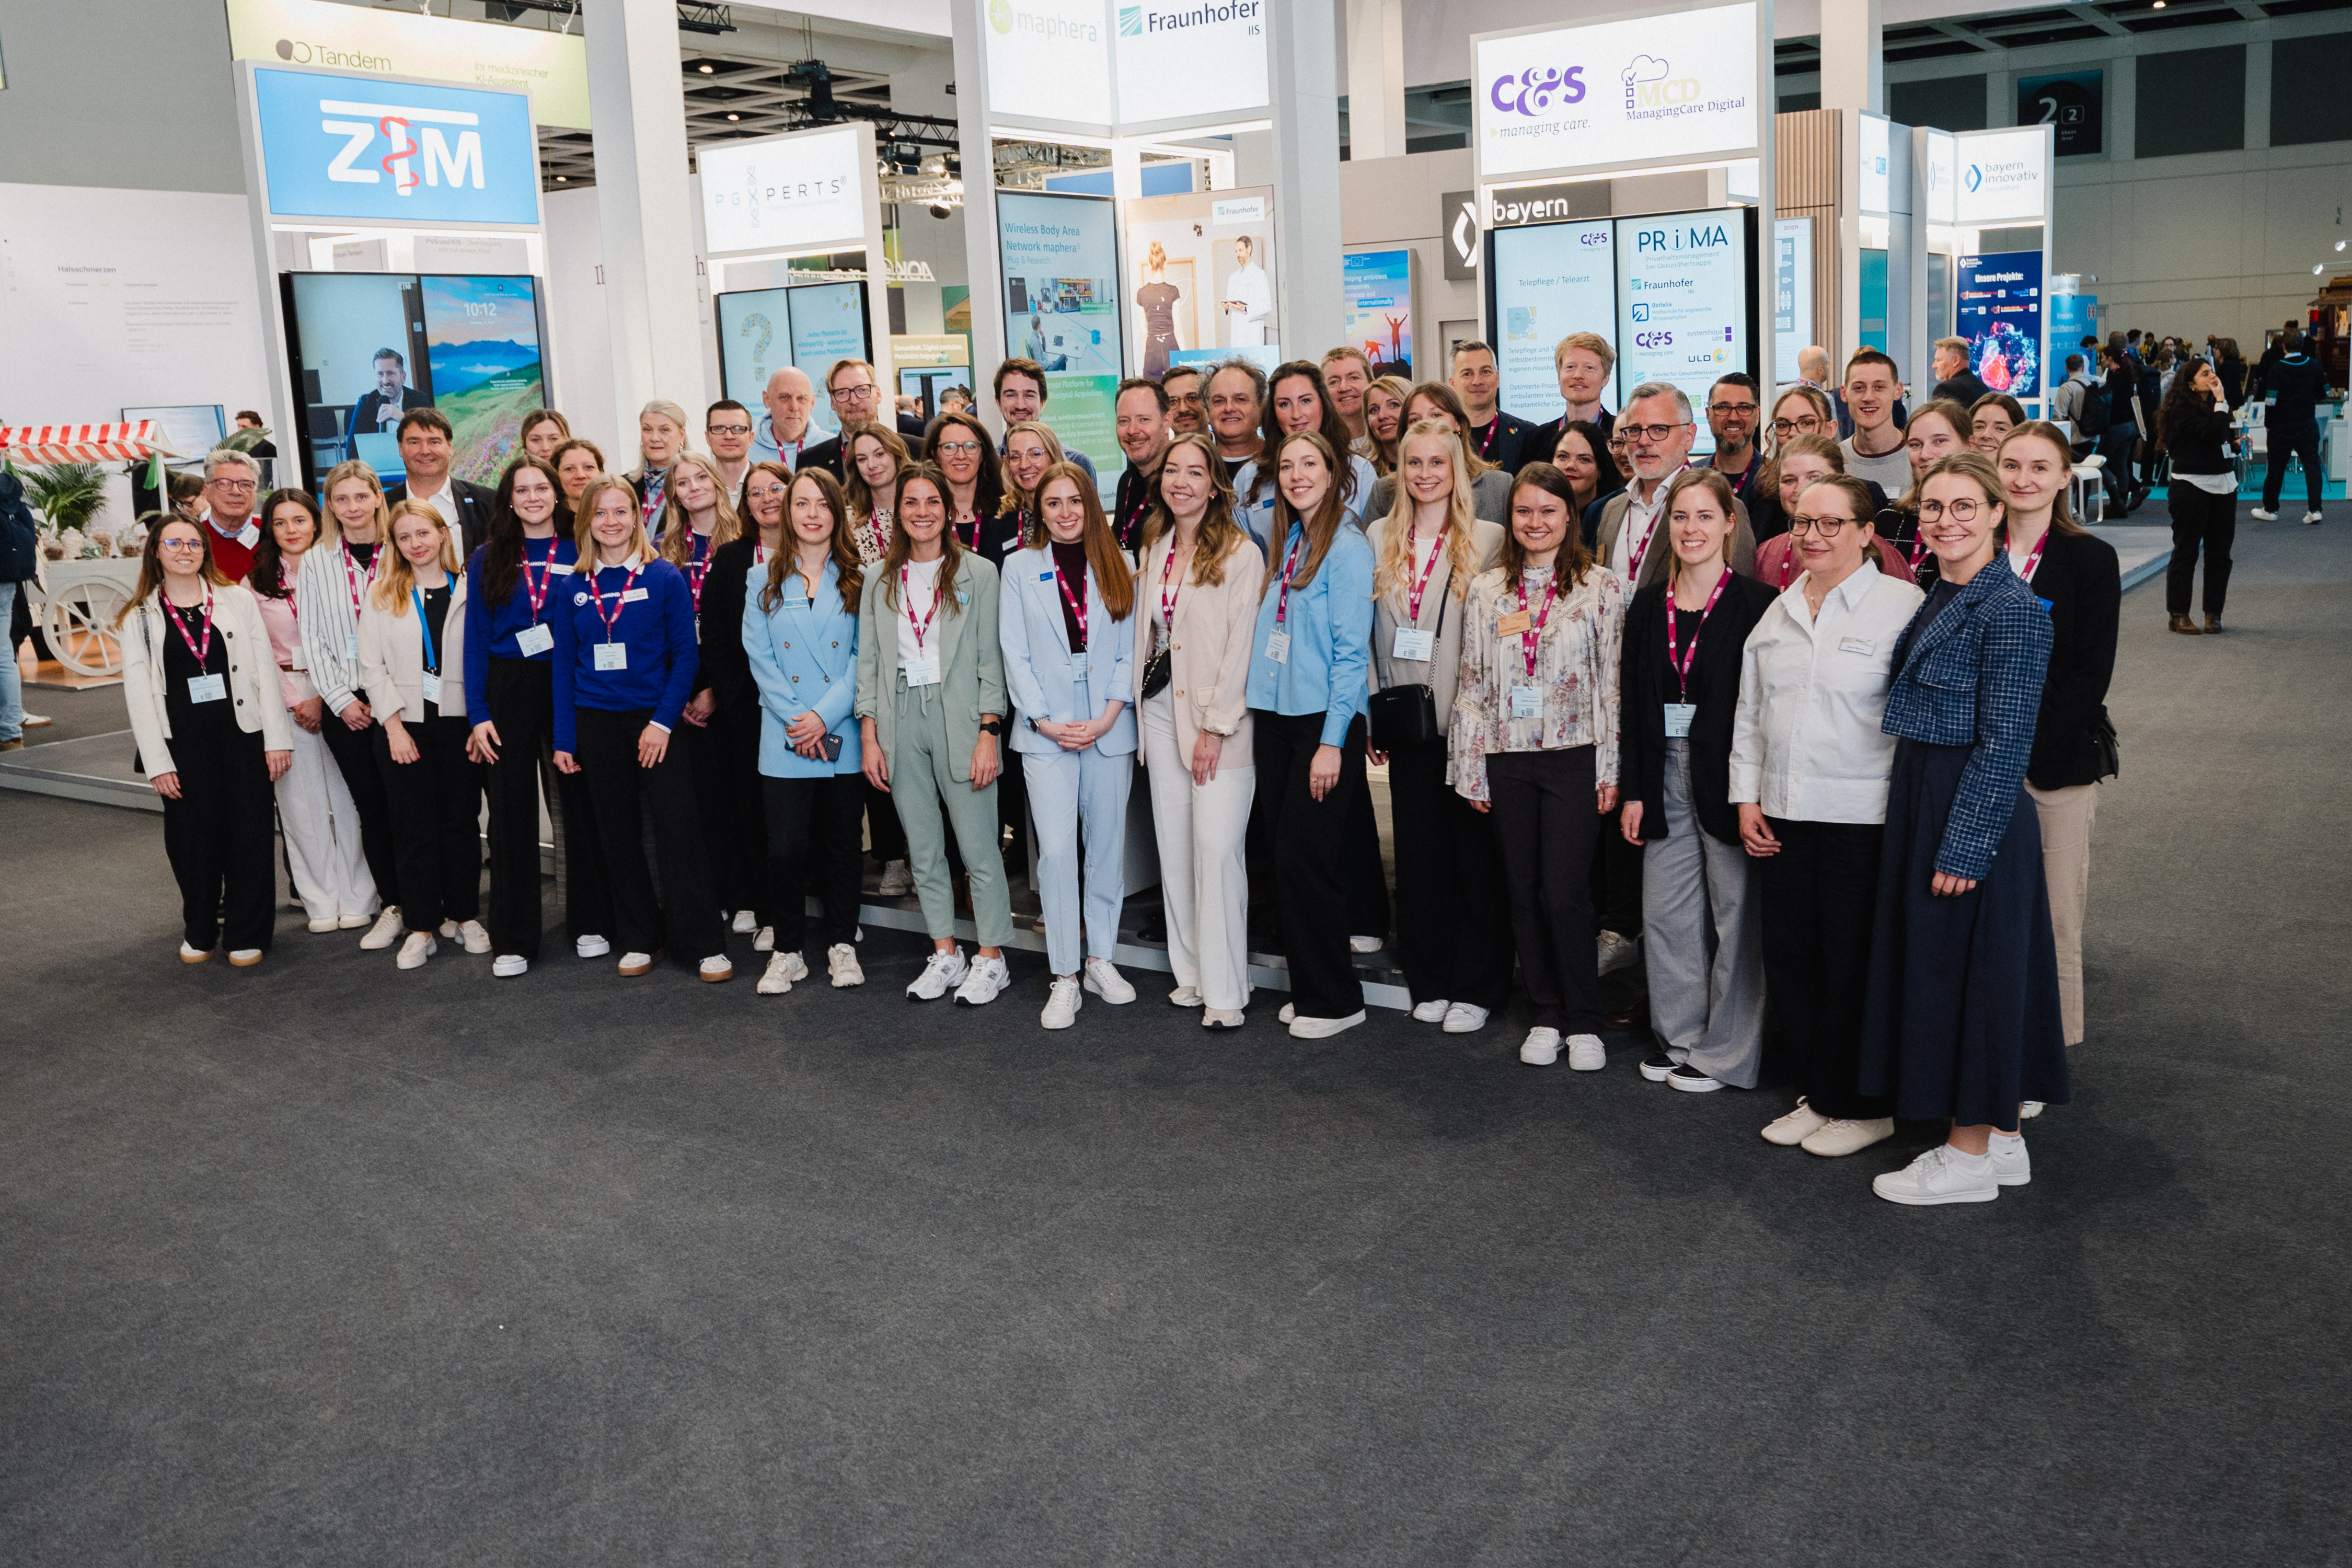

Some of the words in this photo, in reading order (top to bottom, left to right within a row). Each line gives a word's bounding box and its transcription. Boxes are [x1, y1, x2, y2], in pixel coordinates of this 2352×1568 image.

[1148, 0, 1259, 32] Fraunhofer
[1017, 11, 1097, 42] maphera
[1248, 26, 1260, 36] IIS
[315, 45, 391, 71] Tandem
[475, 61, 486, 72] Ihr
[488, 63, 548, 79] medizinischer
[476, 74, 528, 88] KI-Assistent
[1491, 66, 1586, 116] C&S
[1637, 78, 1700, 107] MCD
[1627, 104, 1704, 120] ManagingCare
[1708, 97, 1745, 112] Digital
[2038, 97, 2057, 124] 2
[2069, 109, 2077, 121] 2
[1500, 121, 1560, 137] managing
[1564, 119, 1590, 130] care.
[1986, 162, 2023, 173] bayern
[1986, 171, 2038, 183] innovativ
[1227, 206, 1258, 215] Fraunhofer
[1493, 198, 1567, 224] bayern
[1005, 223, 1038, 234] Wireless
[1041, 224, 1059, 237] Body
[1063, 226, 1079, 236] Area
[1581, 232, 1607, 246] C&S
[1007, 240, 1041, 251] Network
[1007, 256, 1019, 266] Plug
[1027, 256, 1051, 264] Research
[1646, 251, 1720, 262] Privatheitsmanagement
[1657, 260, 1711, 269] Gesundheitsapps
[1519, 278, 1554, 287] Telepflege
[1562, 275, 1589, 284] Telearzt
[1975, 274, 1996, 283] Unsere
[1997, 272, 2024, 283] Projekte:
[1644, 279, 1693, 290] Fraunhofer
[464, 303, 497, 316] 10:12
[806, 330, 820, 338] Jeder
[1636, 330, 1673, 349] C&S
[827, 347, 856, 355] Medikation?
[1063, 379, 1085, 388] Platform
[1049, 392, 1073, 400] Biosignal
[1075, 390, 1103, 399] Acquisition
